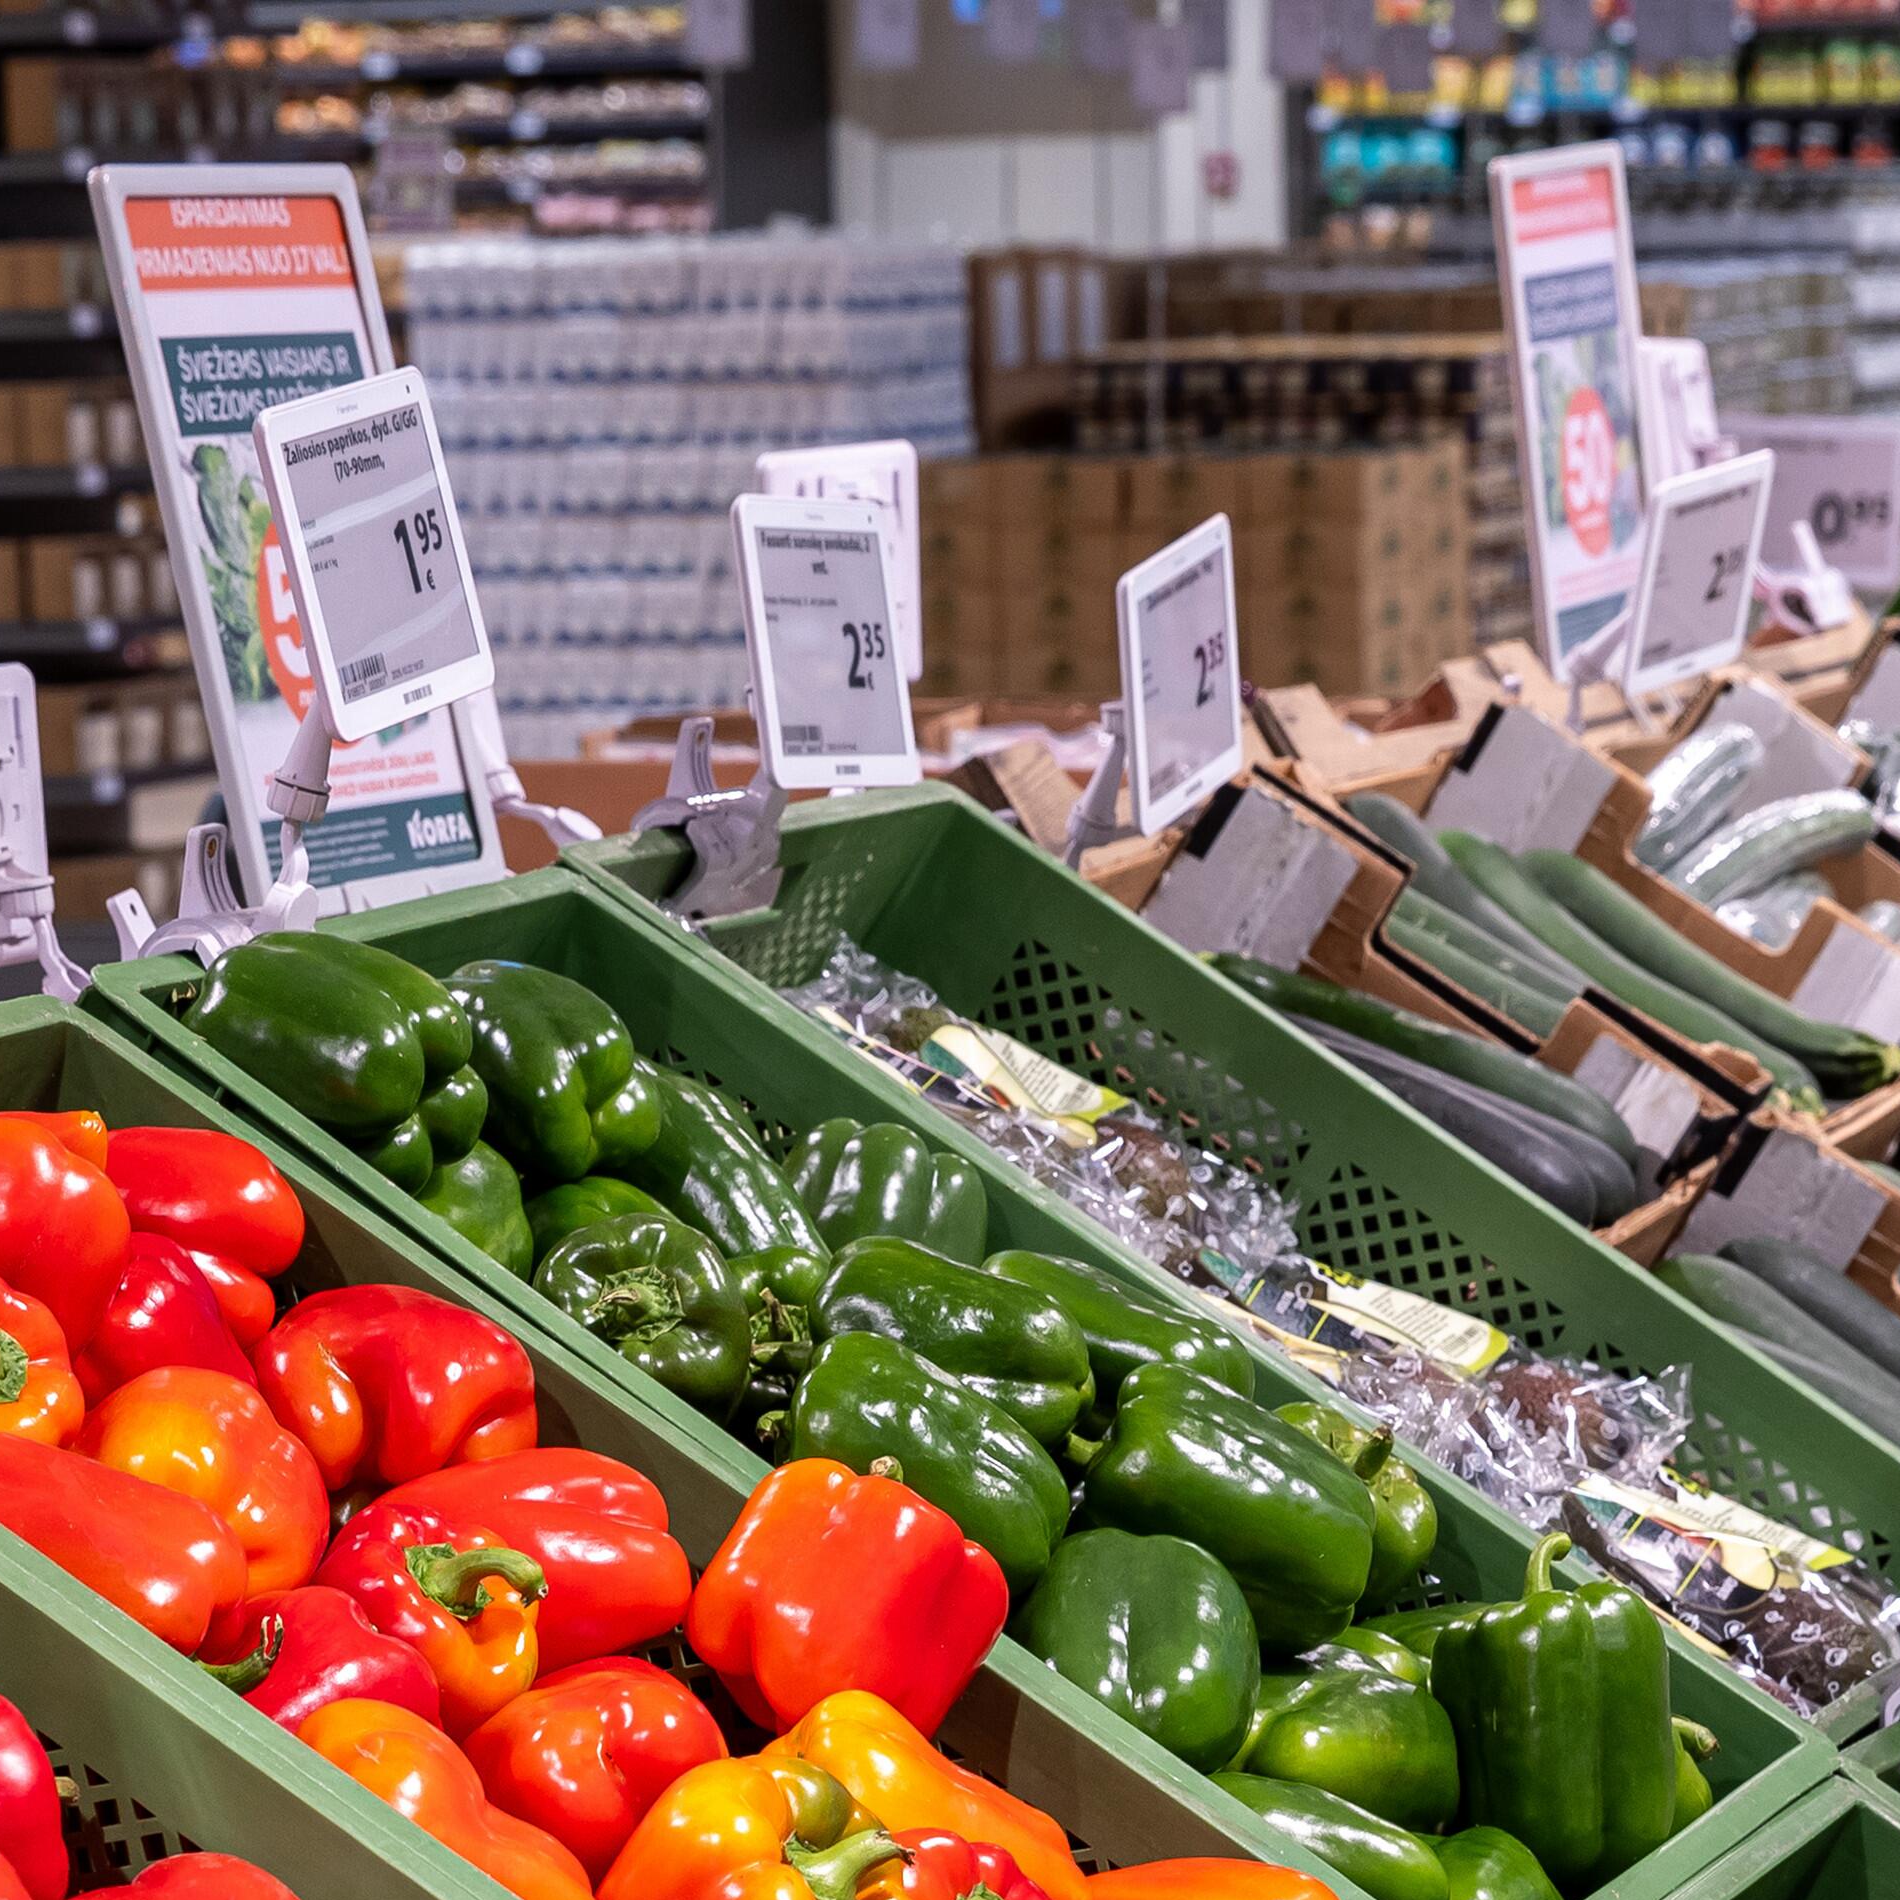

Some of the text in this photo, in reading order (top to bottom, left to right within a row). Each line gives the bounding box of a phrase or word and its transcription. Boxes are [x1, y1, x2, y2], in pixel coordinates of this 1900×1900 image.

[284, 440, 327, 466] Žaliosios
[328, 427, 371, 458] paprikos,
[371, 416, 392, 442] dyd.
[426, 568, 436, 590] €
